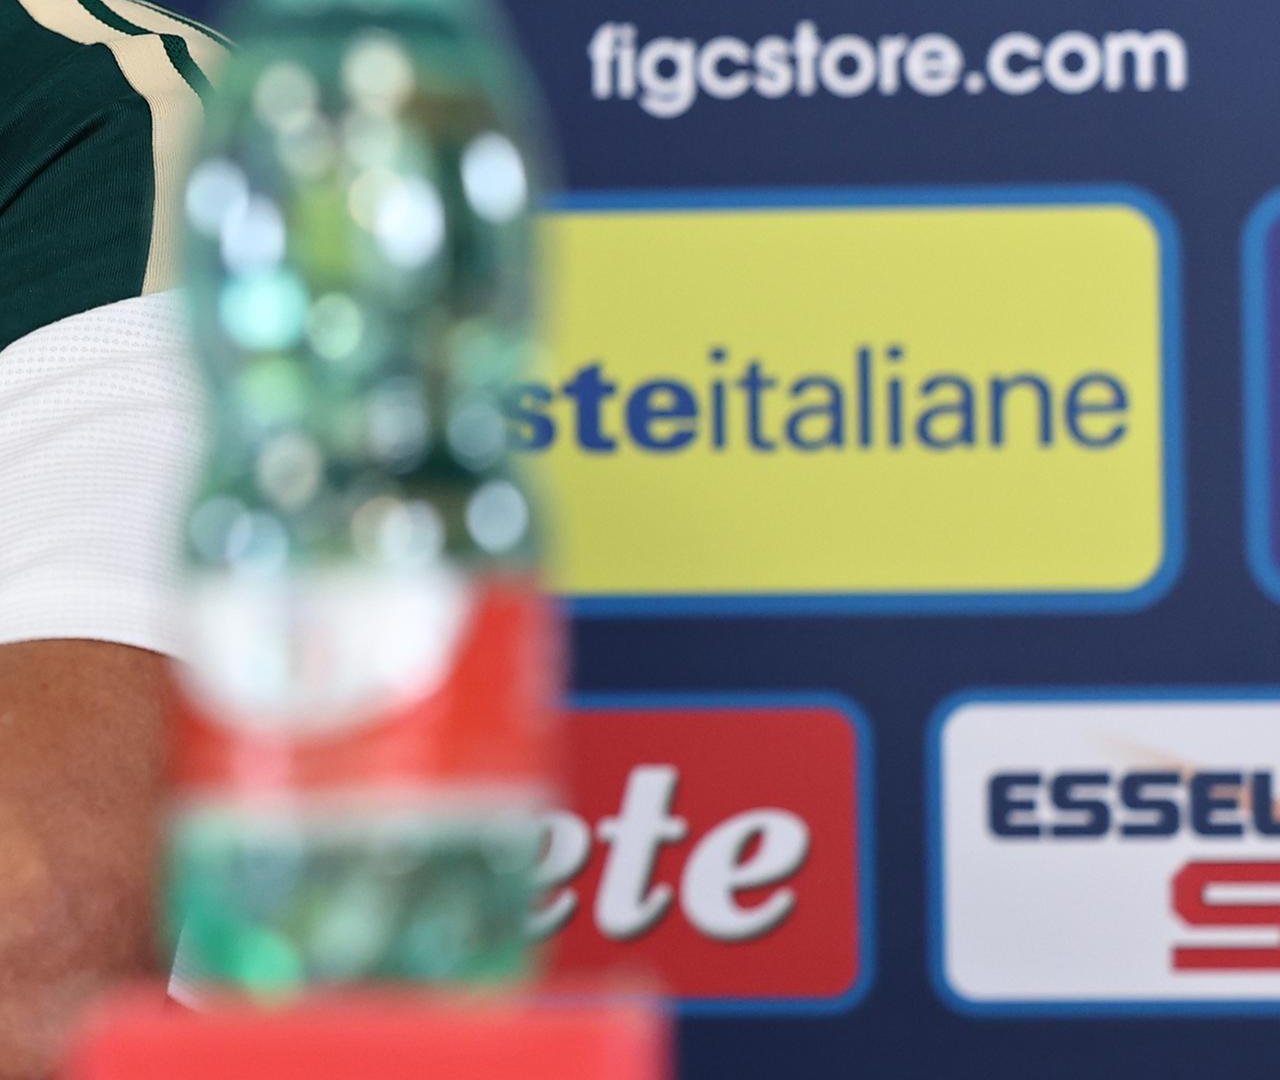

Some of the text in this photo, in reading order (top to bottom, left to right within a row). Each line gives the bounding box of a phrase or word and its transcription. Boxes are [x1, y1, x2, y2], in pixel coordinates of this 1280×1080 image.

[588, 20, 1187, 117] figcstore.com
[500, 345, 1130, 455] steitaliane
[532, 763, 811, 942] ete
